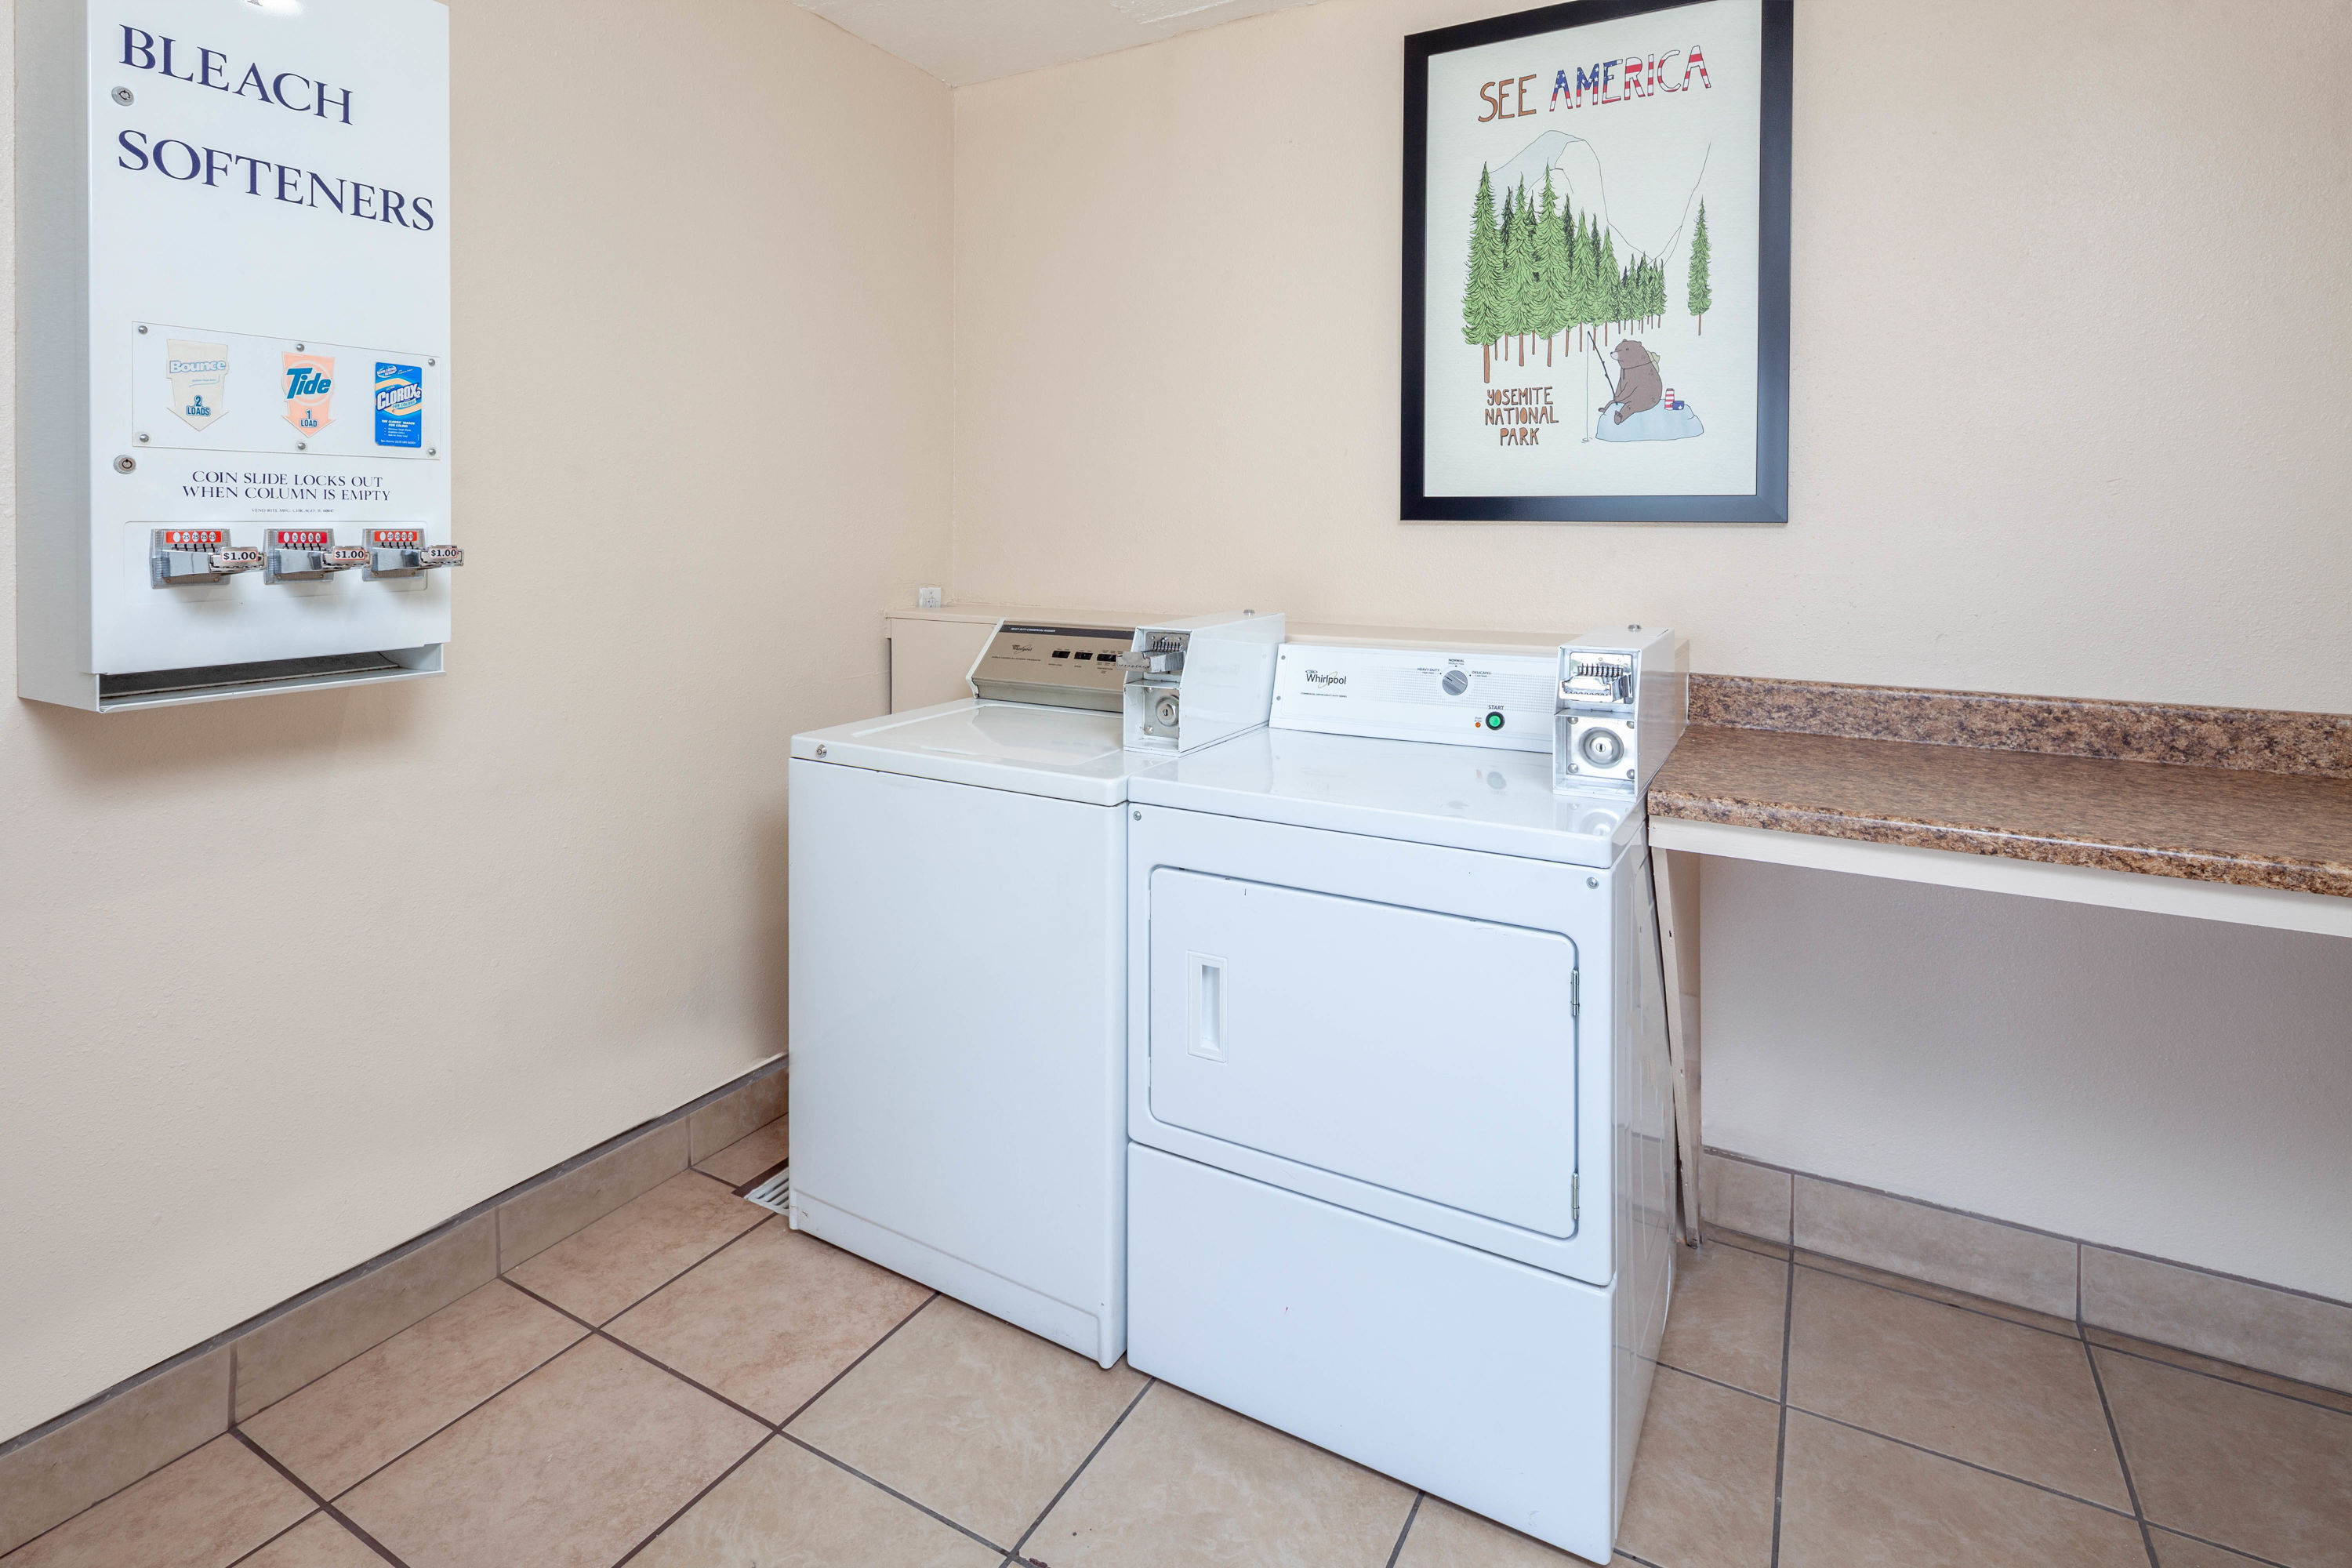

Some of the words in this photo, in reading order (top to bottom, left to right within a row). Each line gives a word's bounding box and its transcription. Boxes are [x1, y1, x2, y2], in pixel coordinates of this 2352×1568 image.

[119, 24, 353, 125] BLEACH
[1478, 74, 1537, 122] SEE
[1549, 45, 1711, 111] AMERICA
[118, 129, 434, 231] SOFTENERS
[169, 360, 227, 374] Bounce
[286, 367, 332, 399] Tide
[194, 394, 202, 407] 2
[1486, 386, 1554, 405] YOSEMITE
[187, 406, 210, 416] LOADS
[305, 409, 311, 419] 1
[1484, 405, 1559, 426] NATIONAL
[300, 419, 318, 427] LOAD
[1500, 426, 1540, 446] PARK
[192, 470, 238, 483] COIN
[244, 472, 288, 485] SLIDE
[294, 474, 346, 486] LOCKS
[351, 476, 383, 487] OUT
[183, 485, 238, 498] WHEN
[245, 487, 317, 499] COLUMN
[324, 488, 336, 500] IS
[342, 489, 390, 501] EMPTY
[223, 551, 256, 561] $1.00
[335, 550, 364, 559] $1.00
[1306, 673, 1347, 686] Whirlpool
